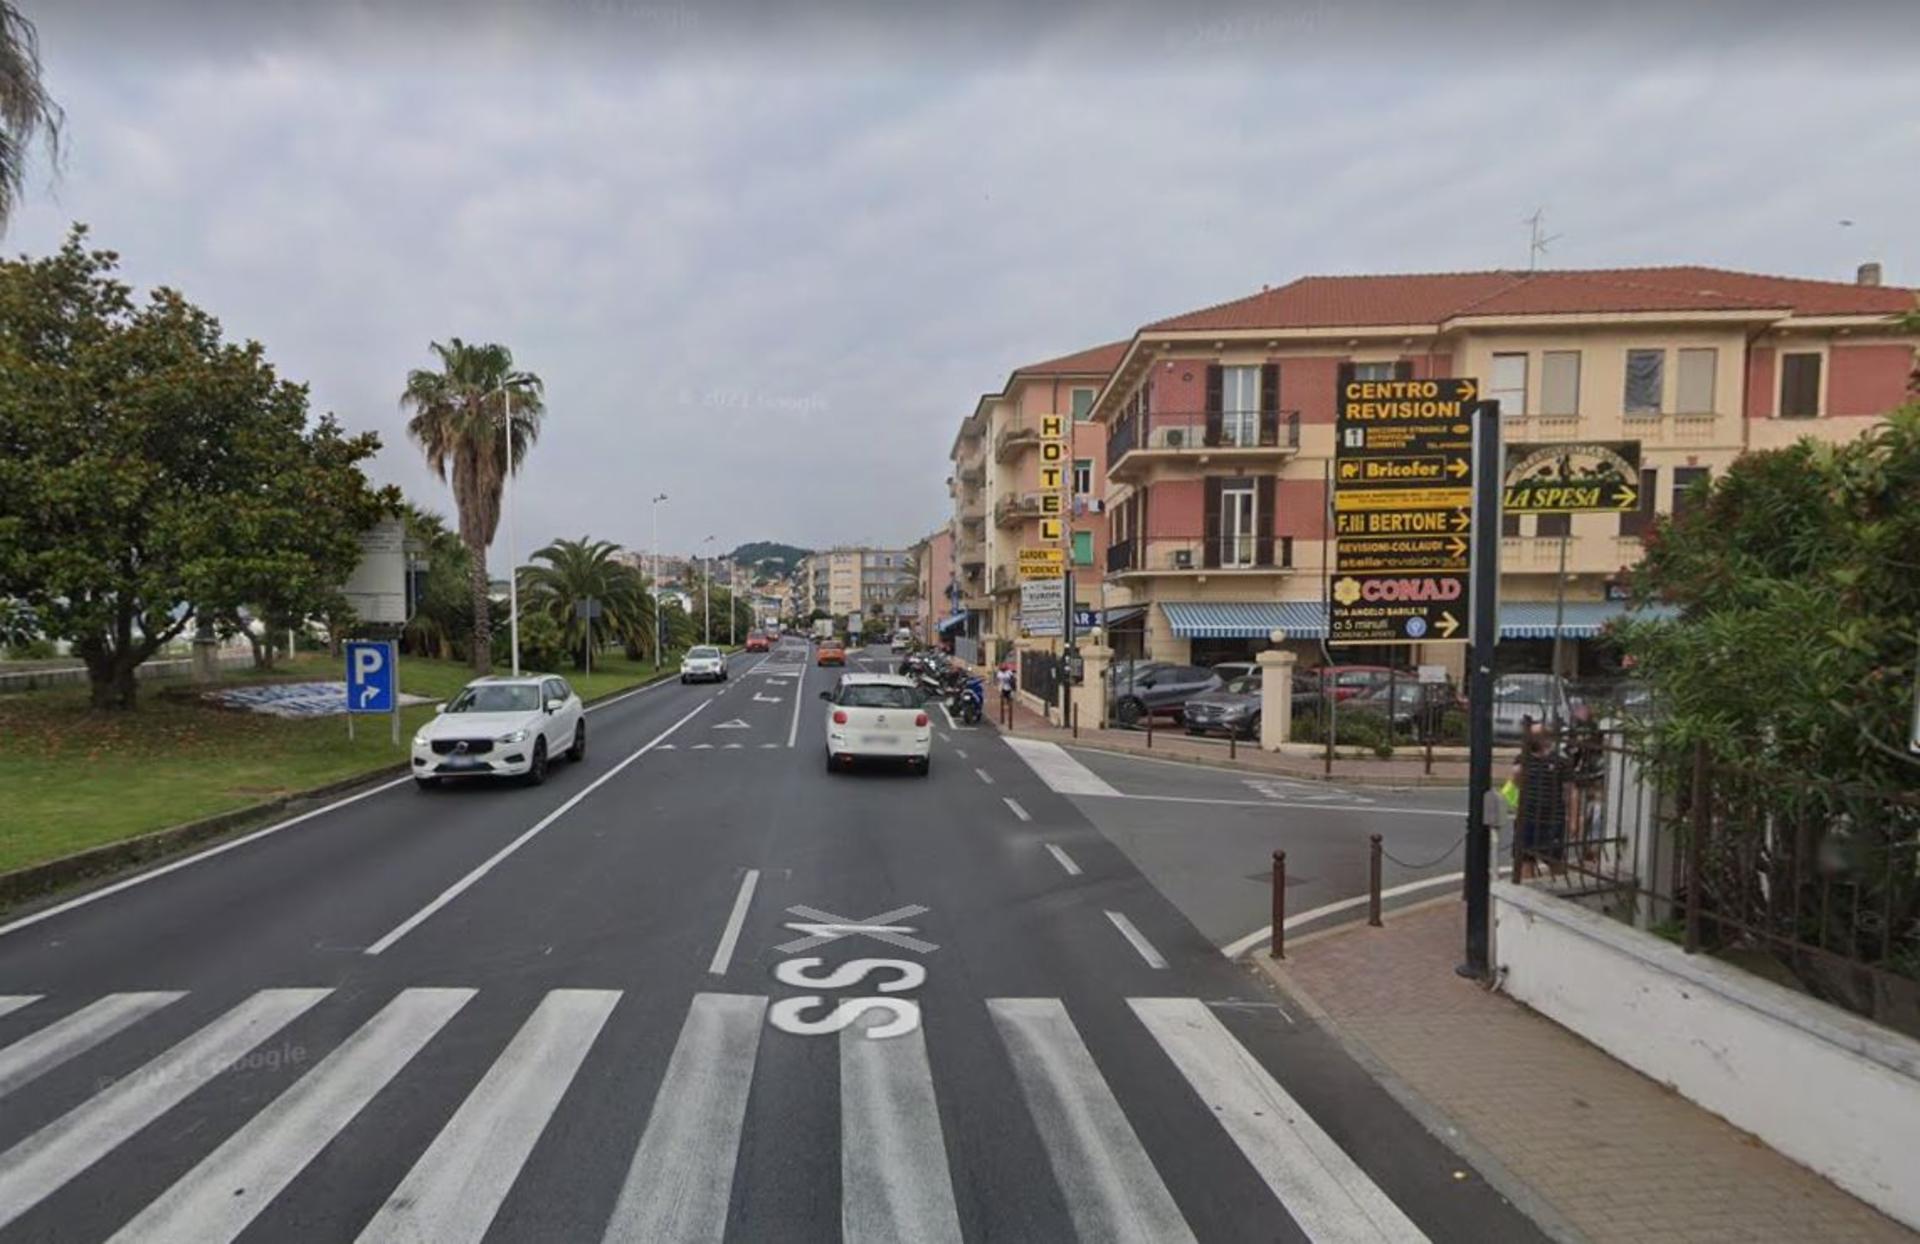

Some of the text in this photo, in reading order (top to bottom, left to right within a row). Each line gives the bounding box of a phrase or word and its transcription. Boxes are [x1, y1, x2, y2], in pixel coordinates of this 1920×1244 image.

[1345, 381, 1438, 399] CENTRO
[1345, 401, 1461, 419] REVISIONI
[1042, 417, 1061, 539] HOTEL
[1366, 461, 1440, 477] Bricofer
[1503, 487, 1601, 507] LA SPESA
[1369, 512, 1447, 531] BERTONE
[1019, 550, 1048, 560] GARDEN
[1020, 565, 1060, 574] RESIDENCE
[1361, 578, 1461, 602] CONAD
[1334, 608, 1349, 616] VIA
[1351, 608, 1384, 616] ANGELO
[354, 648, 383, 685] P
